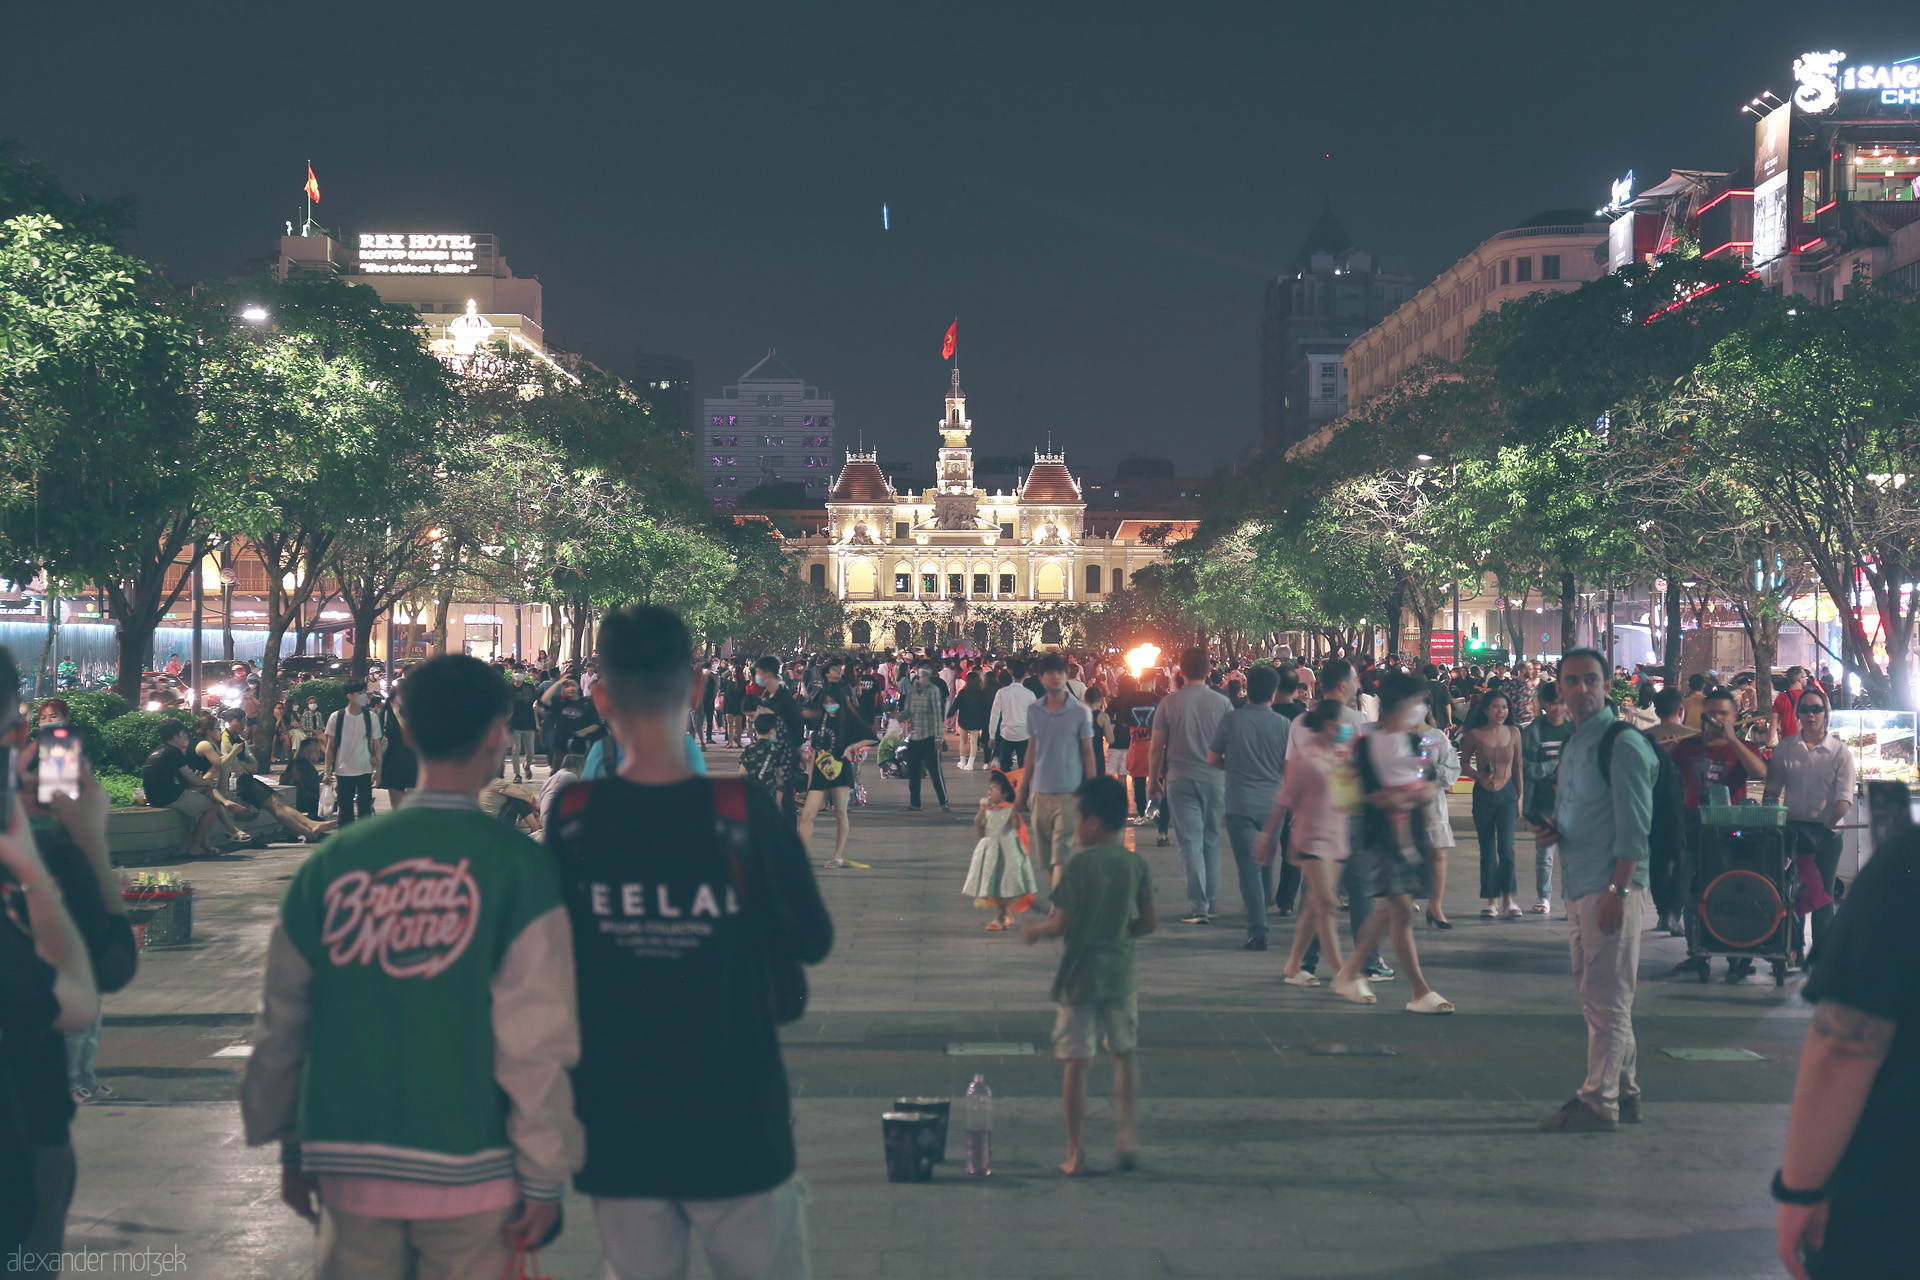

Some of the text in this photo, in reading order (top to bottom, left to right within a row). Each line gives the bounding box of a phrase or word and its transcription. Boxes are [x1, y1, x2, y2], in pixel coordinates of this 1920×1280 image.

[1858, 66, 1920, 88] SAIG
[360, 234, 476, 248] REX HOTEL
[359, 250, 407, 259] ROOFTOP
[452, 251, 473, 260] BAR
[322, 858, 470, 944] Broad
[578, 881, 739, 917] EELA
